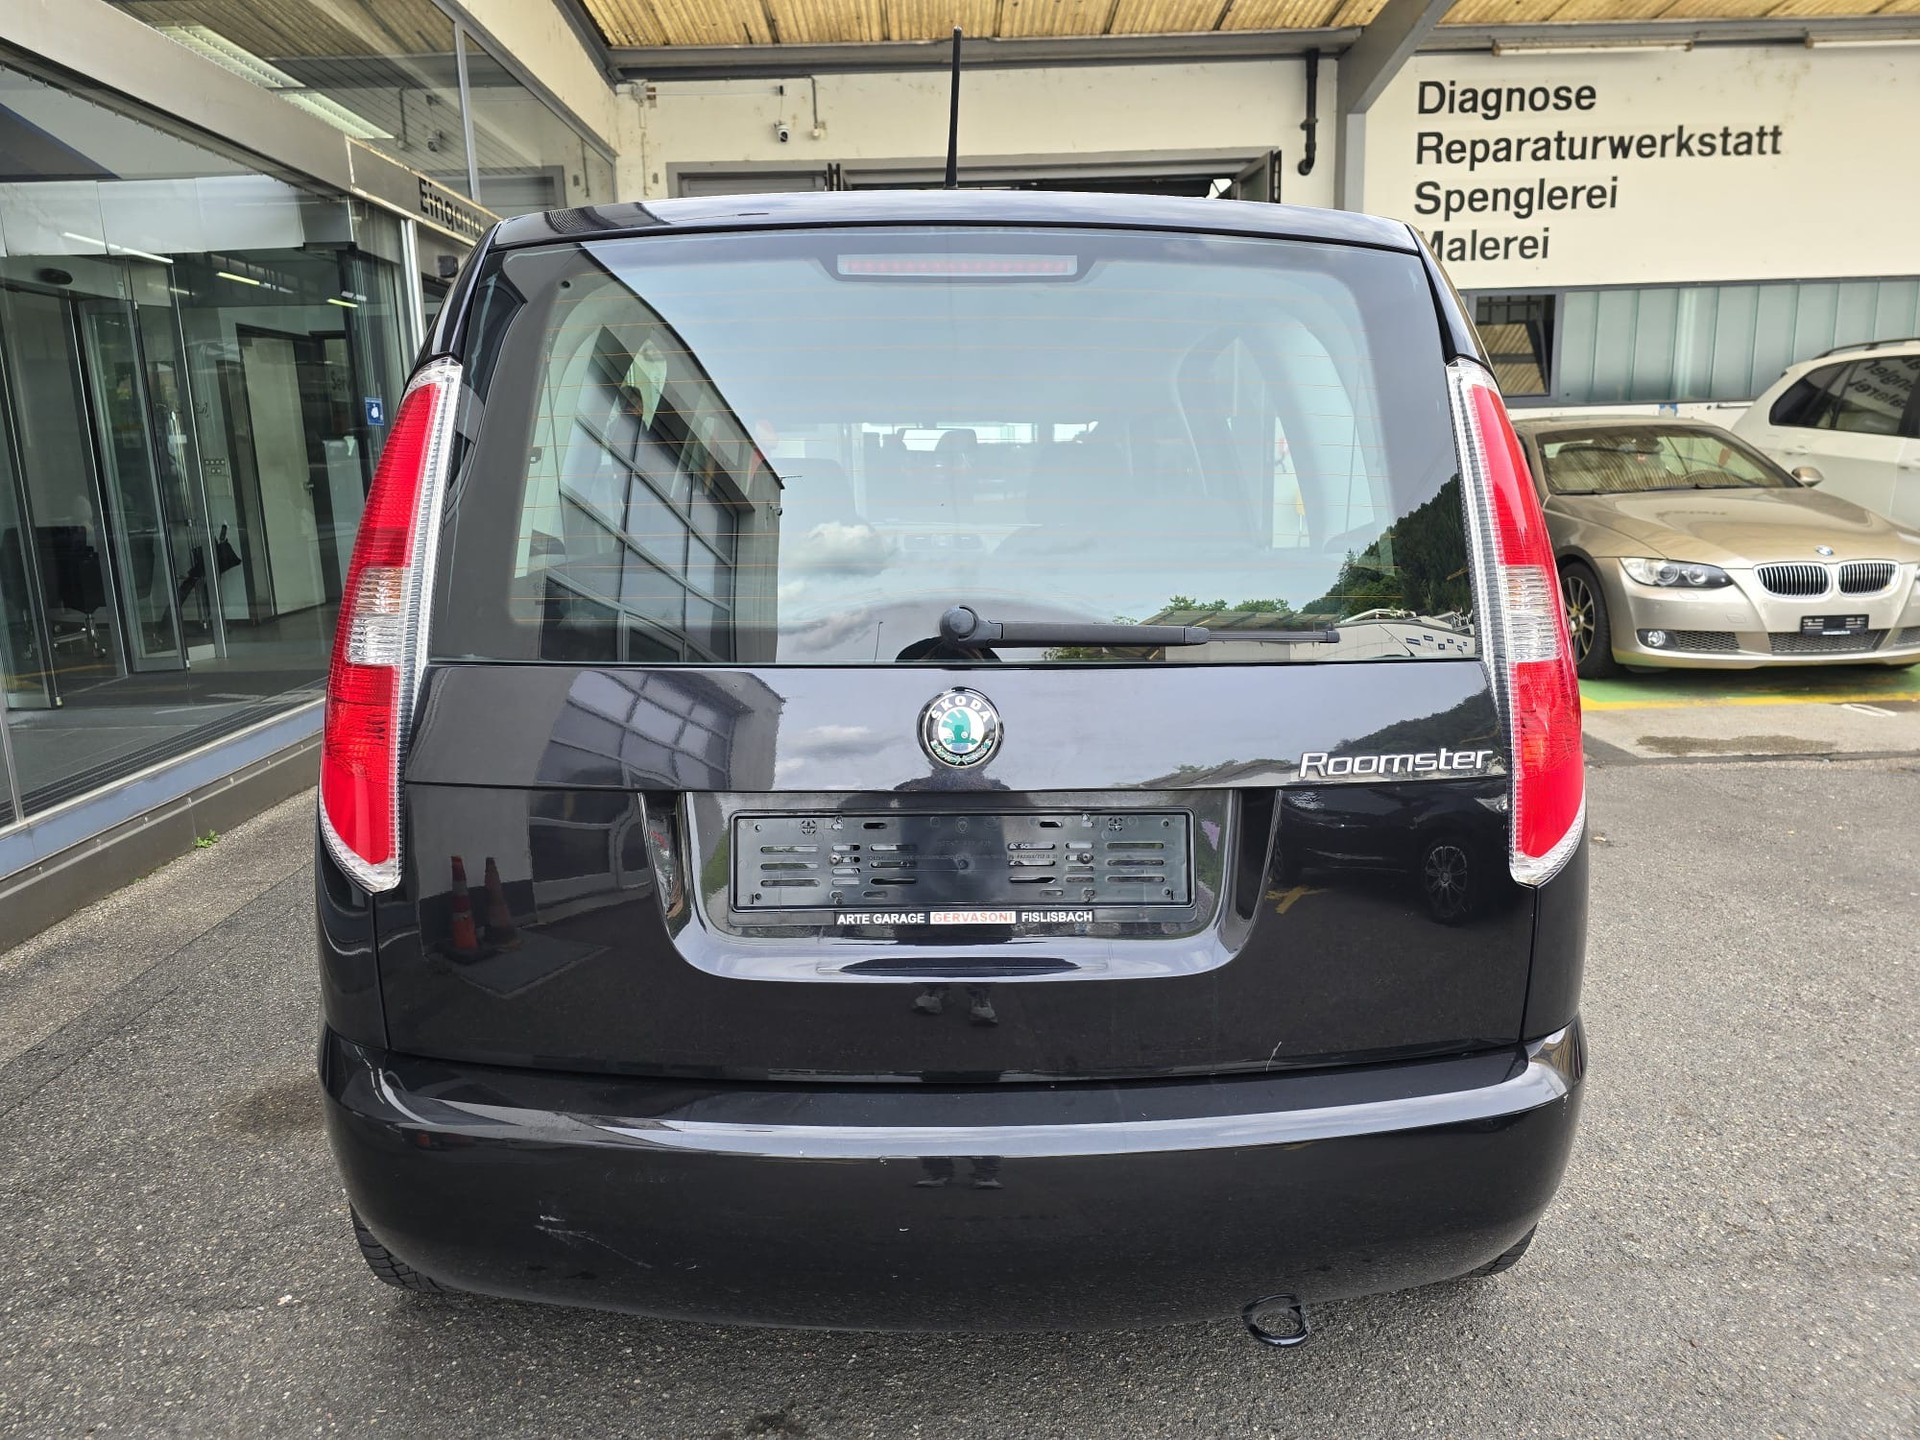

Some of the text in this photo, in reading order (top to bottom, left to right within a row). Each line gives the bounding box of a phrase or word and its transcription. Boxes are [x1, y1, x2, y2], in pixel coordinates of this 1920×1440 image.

[1418, 80, 1597, 121] Diagnose
[1416, 125, 1783, 172] Reparaturwerkstatt
[1414, 176, 1619, 222] Spenglerei
[1298, 747, 1494, 779] Roomster
[836, 911, 1093, 925] ARTE GARAGE GERVASONI FISLISBACH
